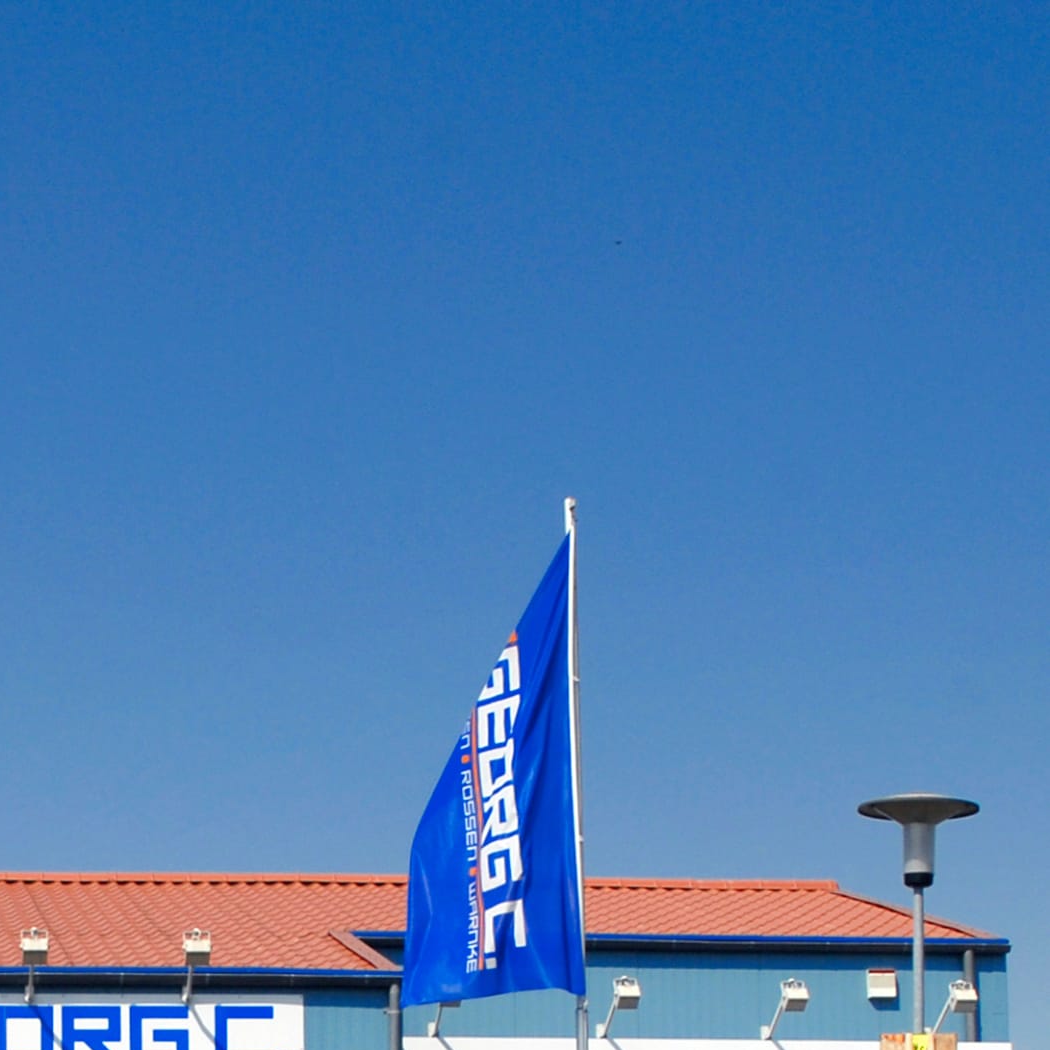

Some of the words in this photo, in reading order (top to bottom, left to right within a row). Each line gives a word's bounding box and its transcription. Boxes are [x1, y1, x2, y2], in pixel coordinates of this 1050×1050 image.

[477, 645, 524, 892] GEORG
[460, 770, 478, 861] ROSSEN
[466, 882, 479, 973] WARNKE
